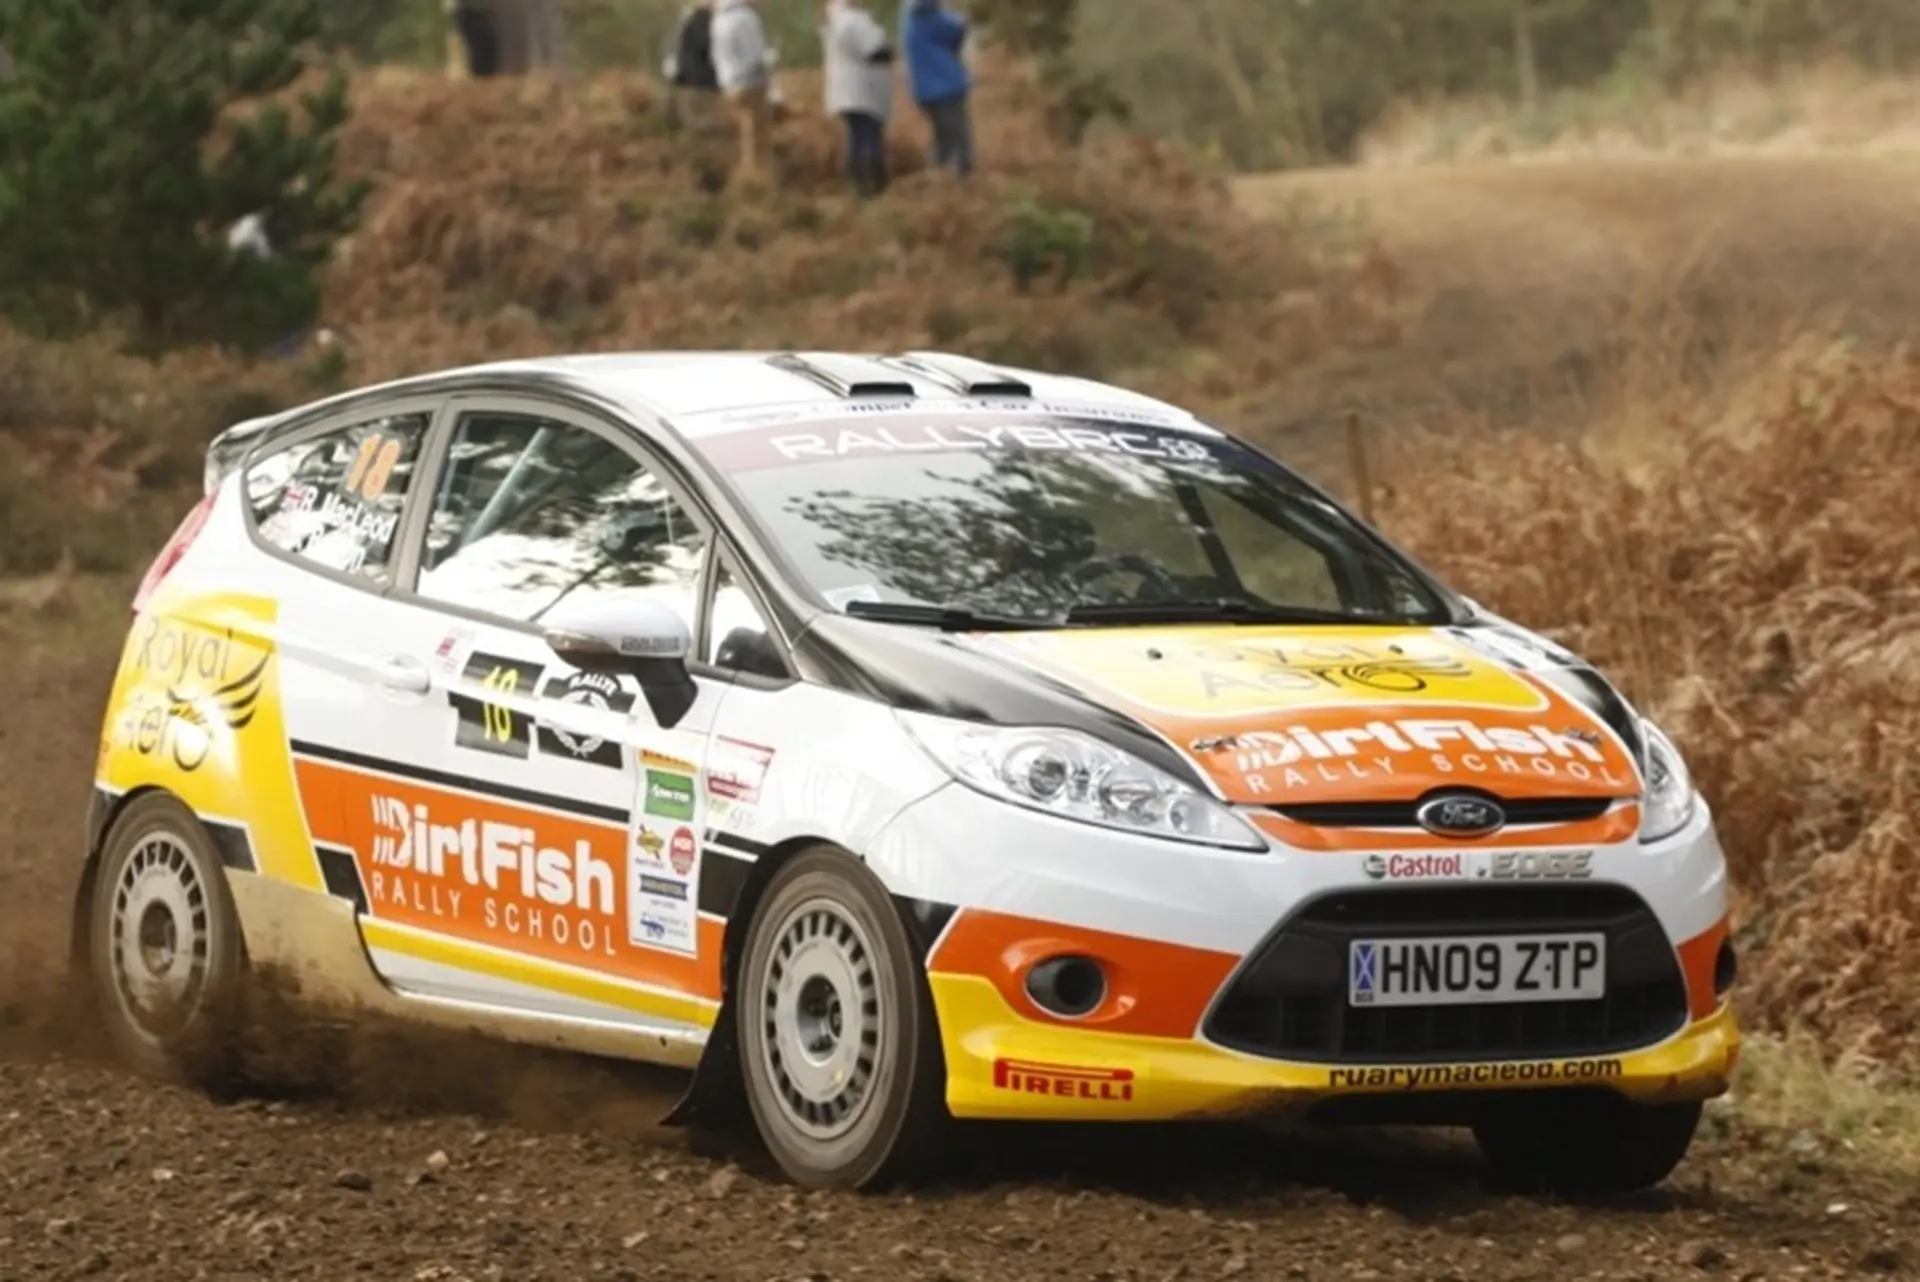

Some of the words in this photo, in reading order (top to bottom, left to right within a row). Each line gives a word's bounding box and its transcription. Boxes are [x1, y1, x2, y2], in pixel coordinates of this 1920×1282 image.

[345, 433, 400, 500] 18
[136, 615, 231, 685] Royal
[1236, 718, 1605, 771] DirtFish
[1246, 755, 1394, 794] RALLY
[1432, 754, 1624, 788] SCHOOL
[1441, 802, 1488, 825] Ford
[371, 794, 616, 916] DirtFish
[1388, 853, 1462, 878] Castrol
[1491, 851, 1593, 879] EDGE
[372, 871, 461, 918] RALLY
[485, 897, 616, 956] SCHOOL
[1381, 943, 1502, 994] HN09
[1514, 940, 1599, 991] ZTP
[993, 1057, 1134, 1102] PIRELLI
